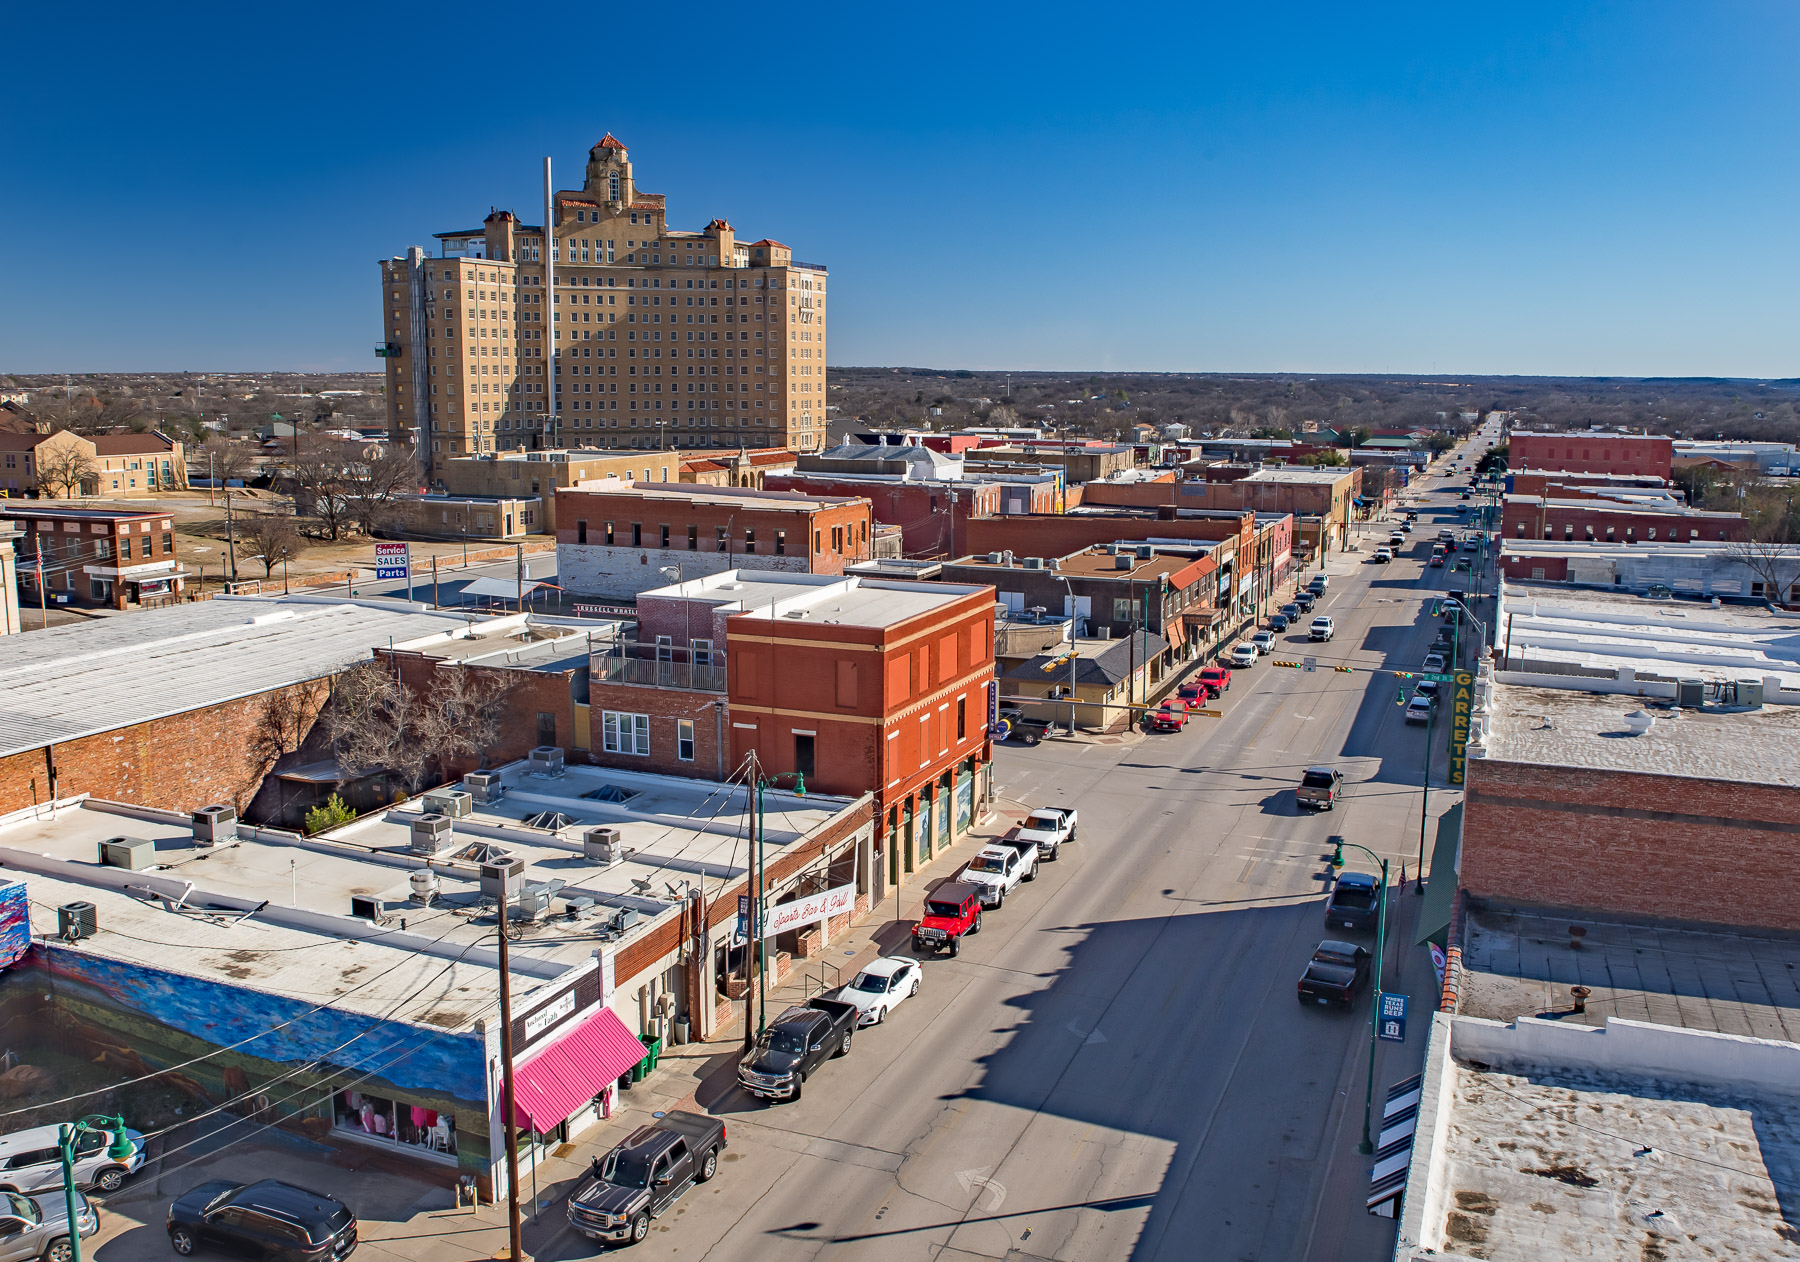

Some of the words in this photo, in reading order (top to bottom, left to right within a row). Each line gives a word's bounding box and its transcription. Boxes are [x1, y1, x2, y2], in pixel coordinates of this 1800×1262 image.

[377, 546, 405, 555] Service
[377, 556, 406, 566] SALES
[379, 569, 405, 577] Parts
[580, 605, 610, 613] RUSSELL
[1452, 673, 1472, 783] GARRETTS
[773, 907, 800, 930] Sports
[801, 903, 819, 920] Bar
[819, 898, 828, 914] &
[829, 891, 849, 912] Grill
